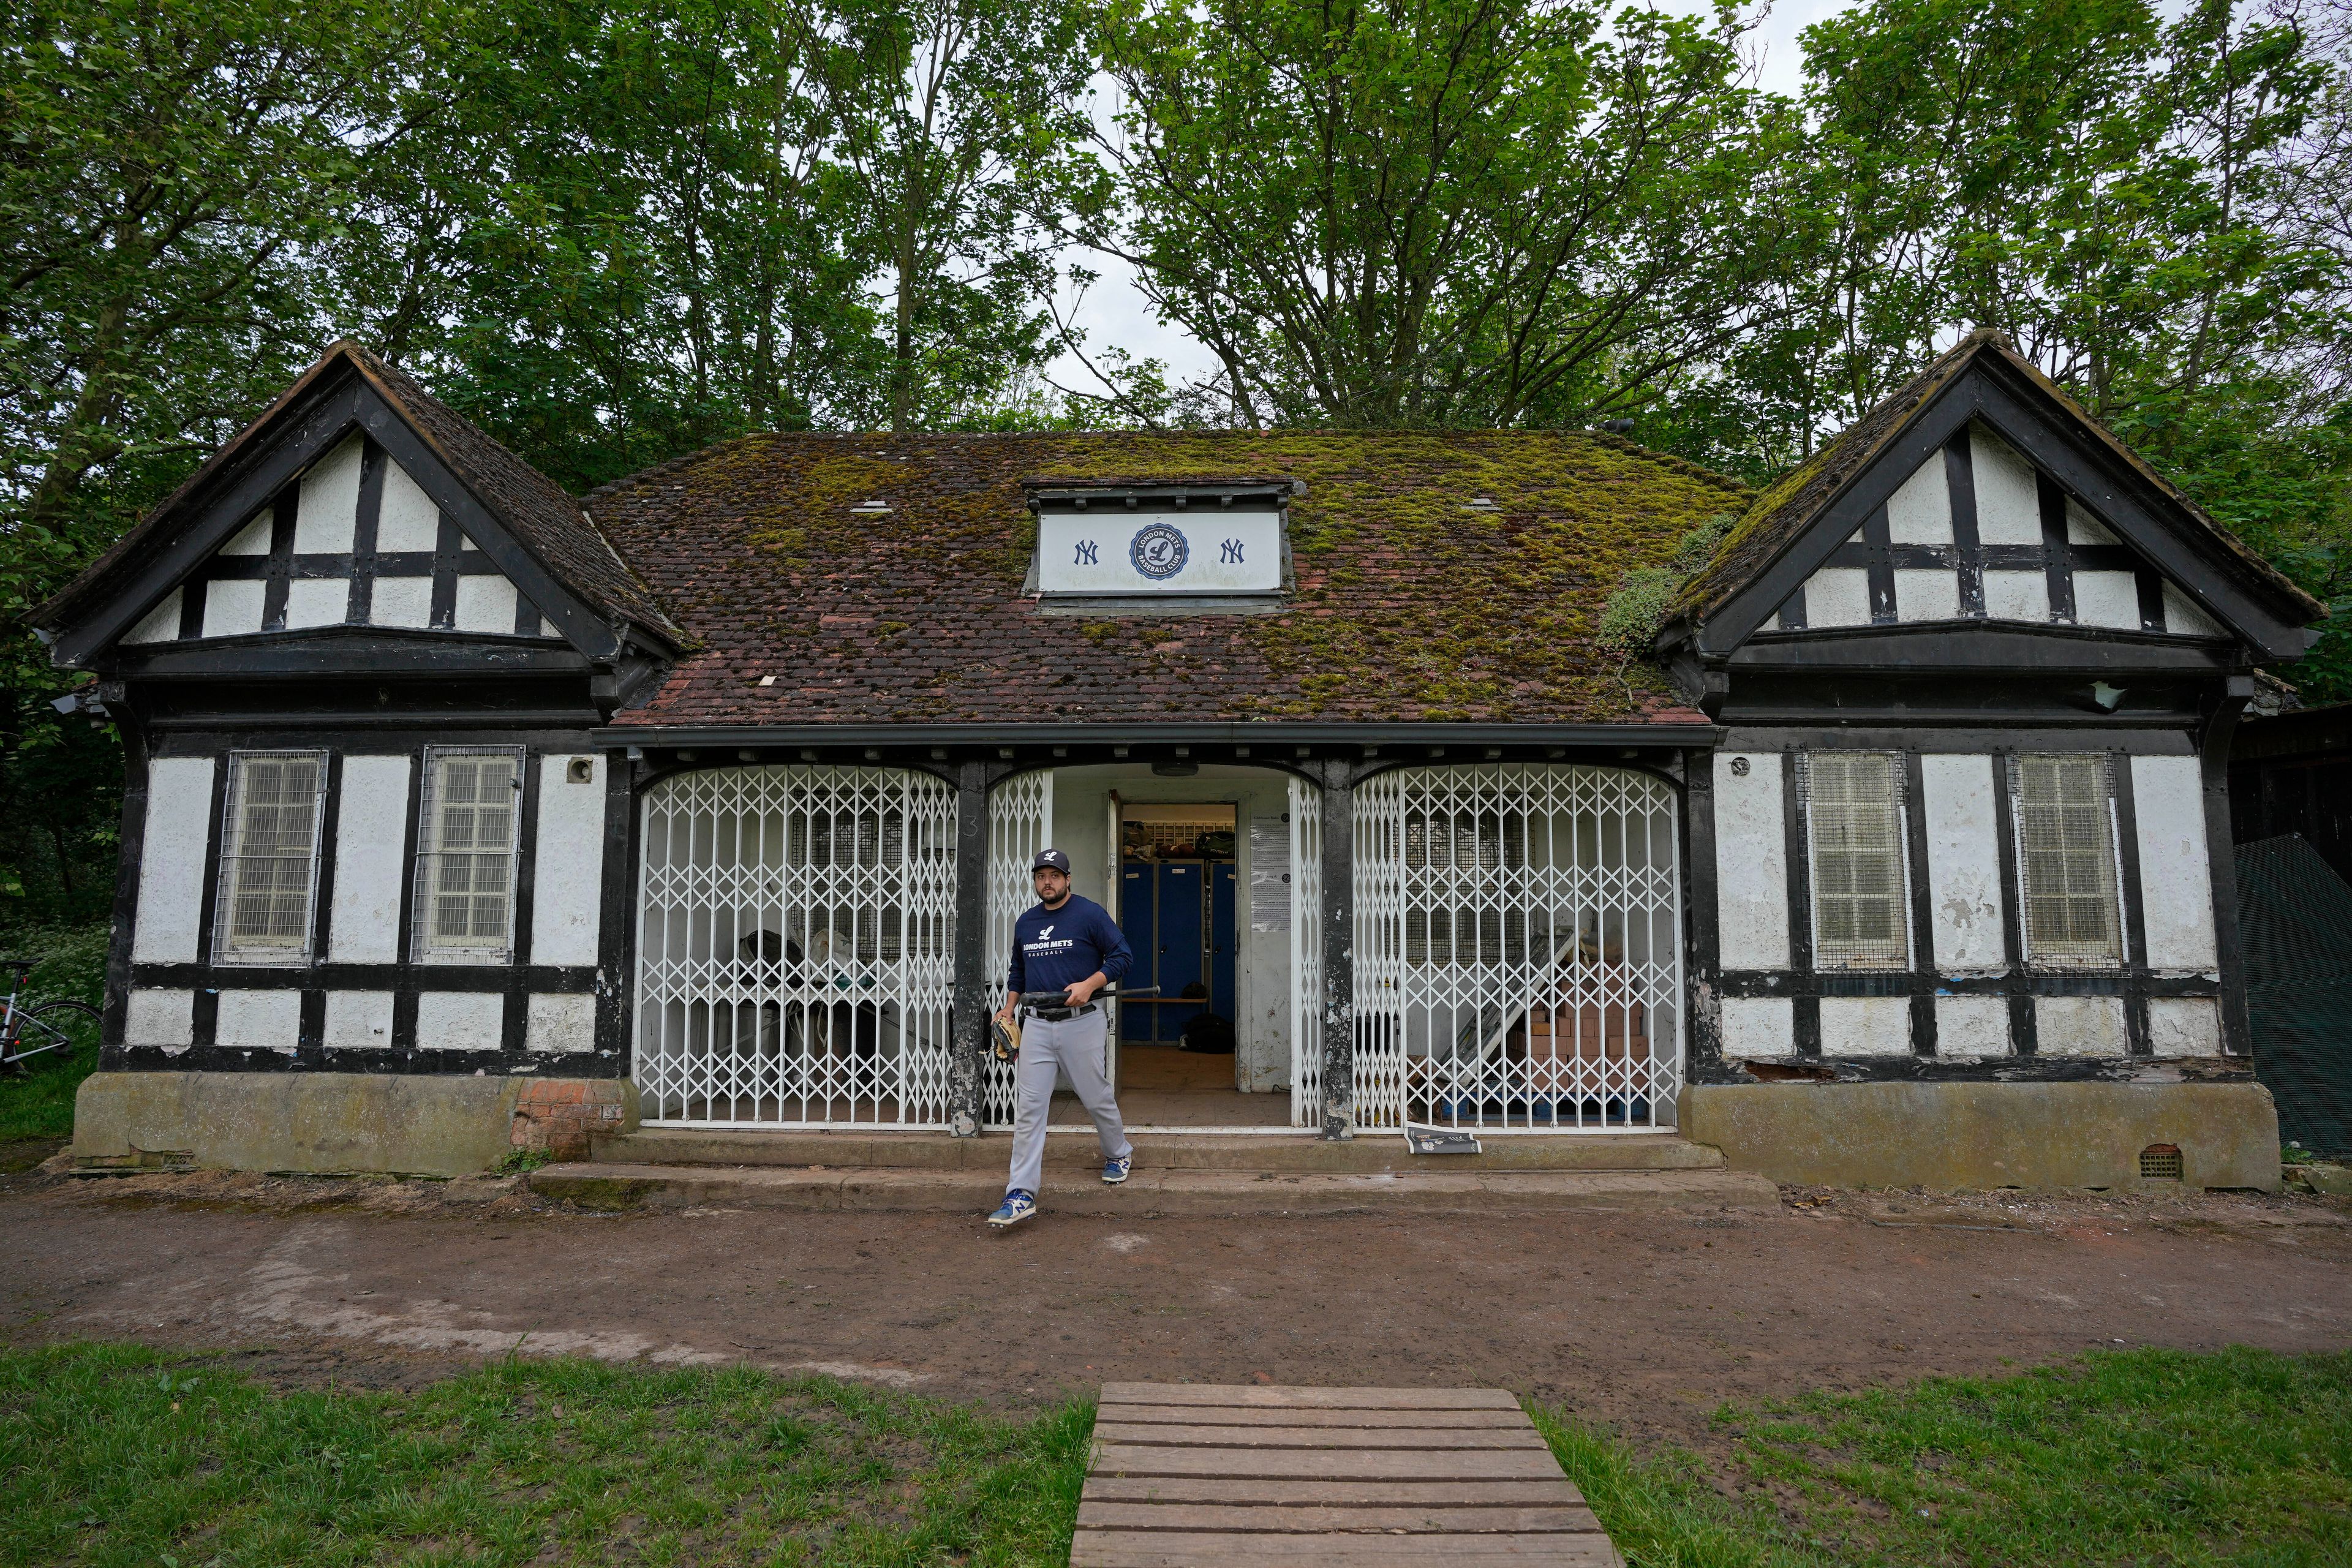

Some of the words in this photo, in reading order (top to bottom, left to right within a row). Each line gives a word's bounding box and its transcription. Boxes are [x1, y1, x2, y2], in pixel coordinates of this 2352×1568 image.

[1138, 530, 1164, 548] LONDON
[1165, 532, 1180, 549] METS
[1074, 539, 1098, 565] NY
[1148, 541, 1169, 562] L
[1220, 538, 1245, 564] NY
[1138, 554, 1167, 573] BASEBALL
[1167, 554, 1180, 570] CLUB
[1044, 851, 1057, 861] L
[1038, 925, 1054, 940] L
[1023, 941, 1049, 951] LONDON
[1050, 940, 1073, 948] METS
